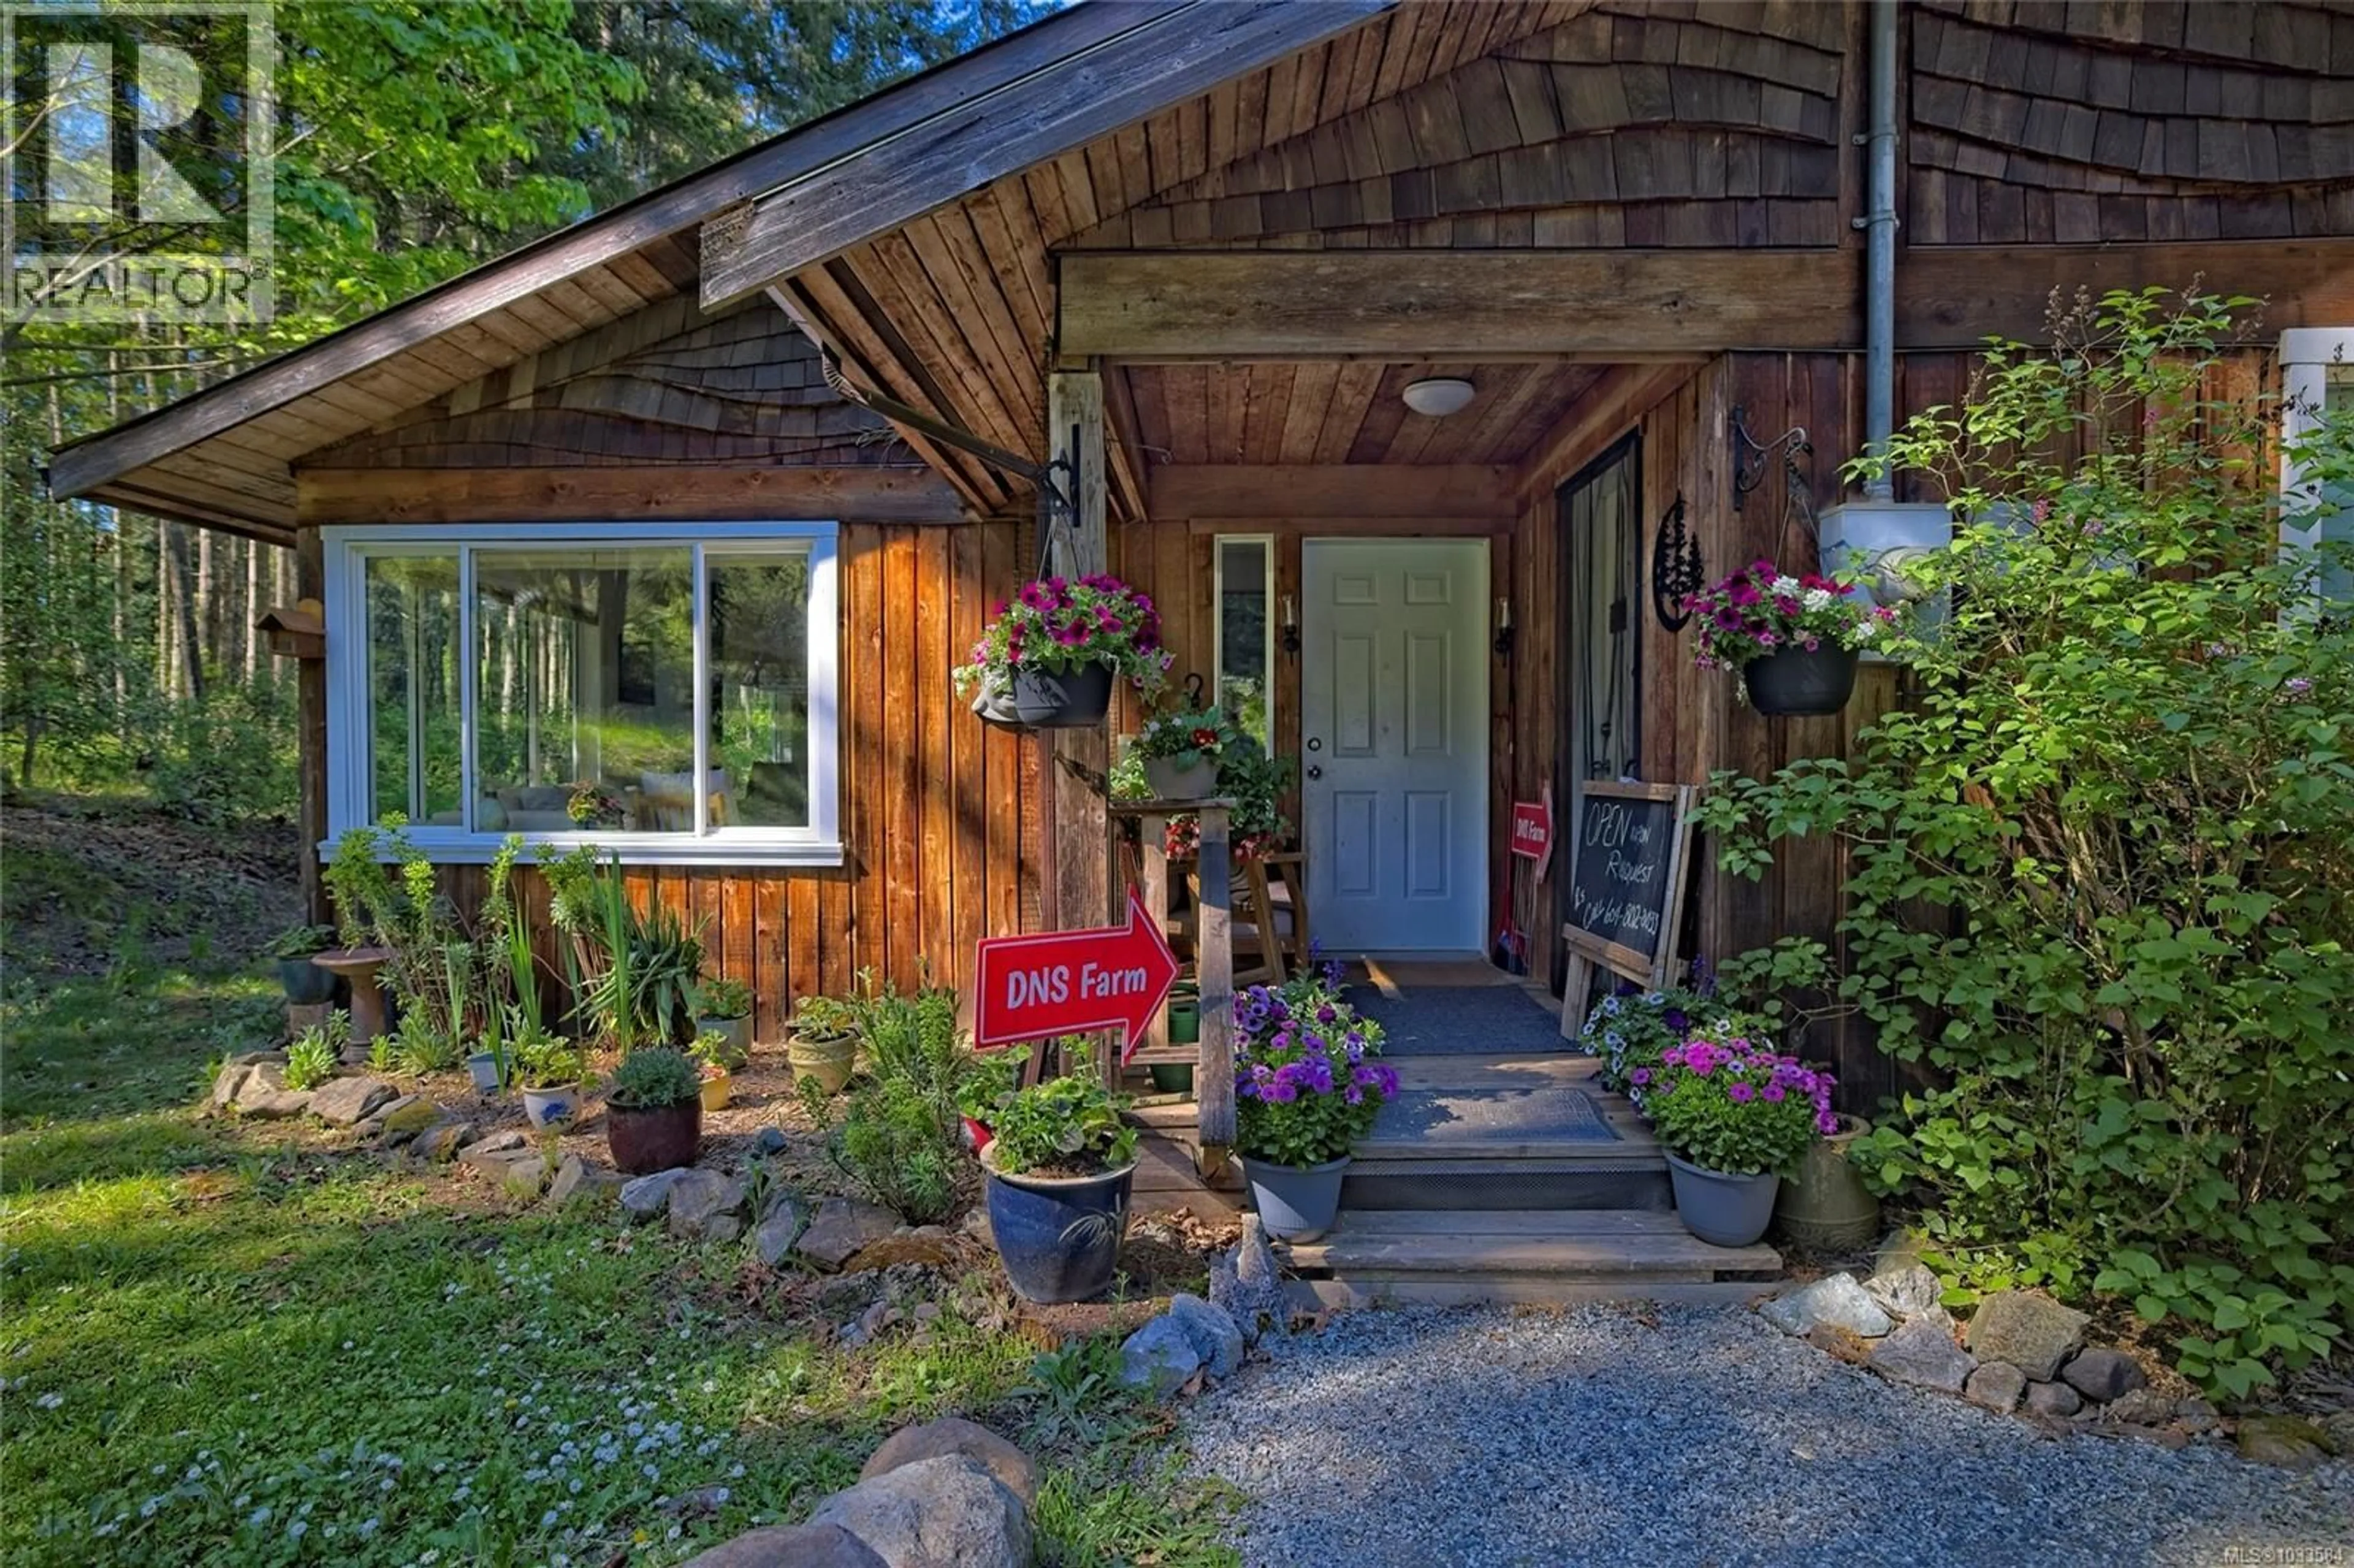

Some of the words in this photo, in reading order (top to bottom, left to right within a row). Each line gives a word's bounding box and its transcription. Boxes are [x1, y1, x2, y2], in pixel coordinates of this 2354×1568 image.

[1586, 802, 1633, 847] OPEN
[1007, 964, 1070, 1010] DNS
[1080, 962, 1148, 1000] Farm
